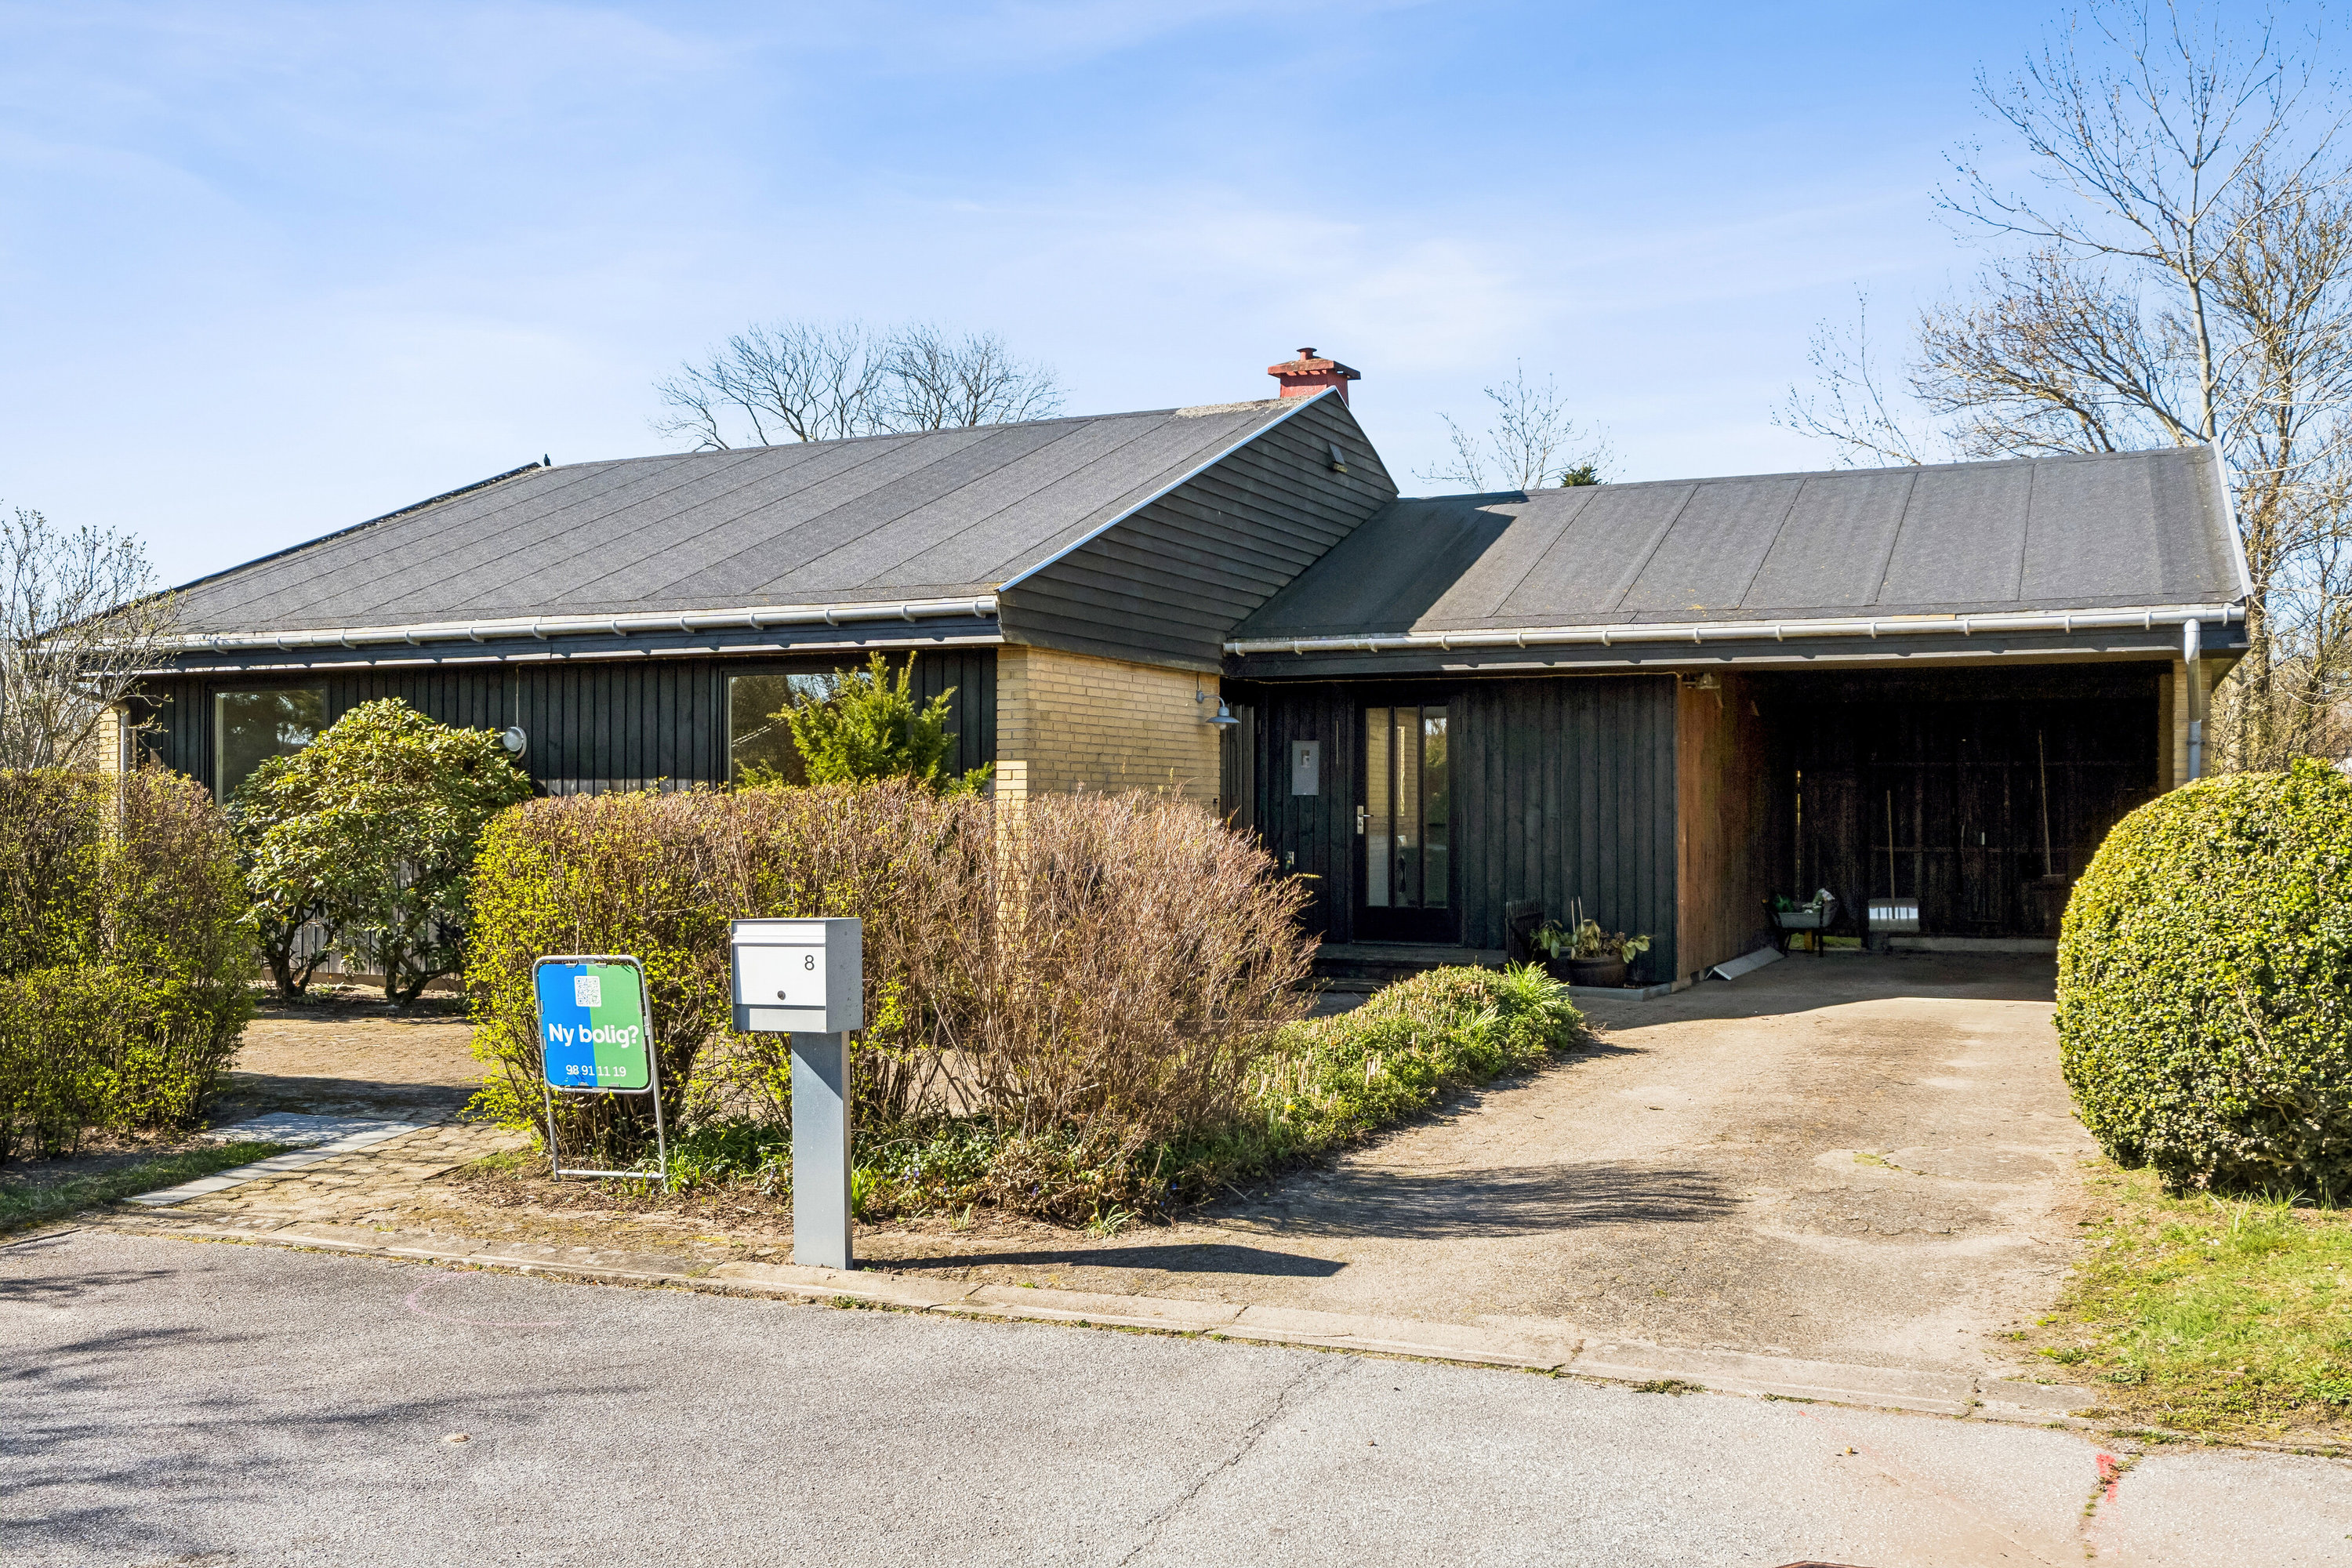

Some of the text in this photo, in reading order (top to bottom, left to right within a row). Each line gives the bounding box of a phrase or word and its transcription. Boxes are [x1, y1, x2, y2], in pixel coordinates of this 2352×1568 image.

[804, 955, 815, 971] 8
[549, 1023, 639, 1048] Ny bolig?
[565, 1065, 626, 1076] 98 91 11 19
